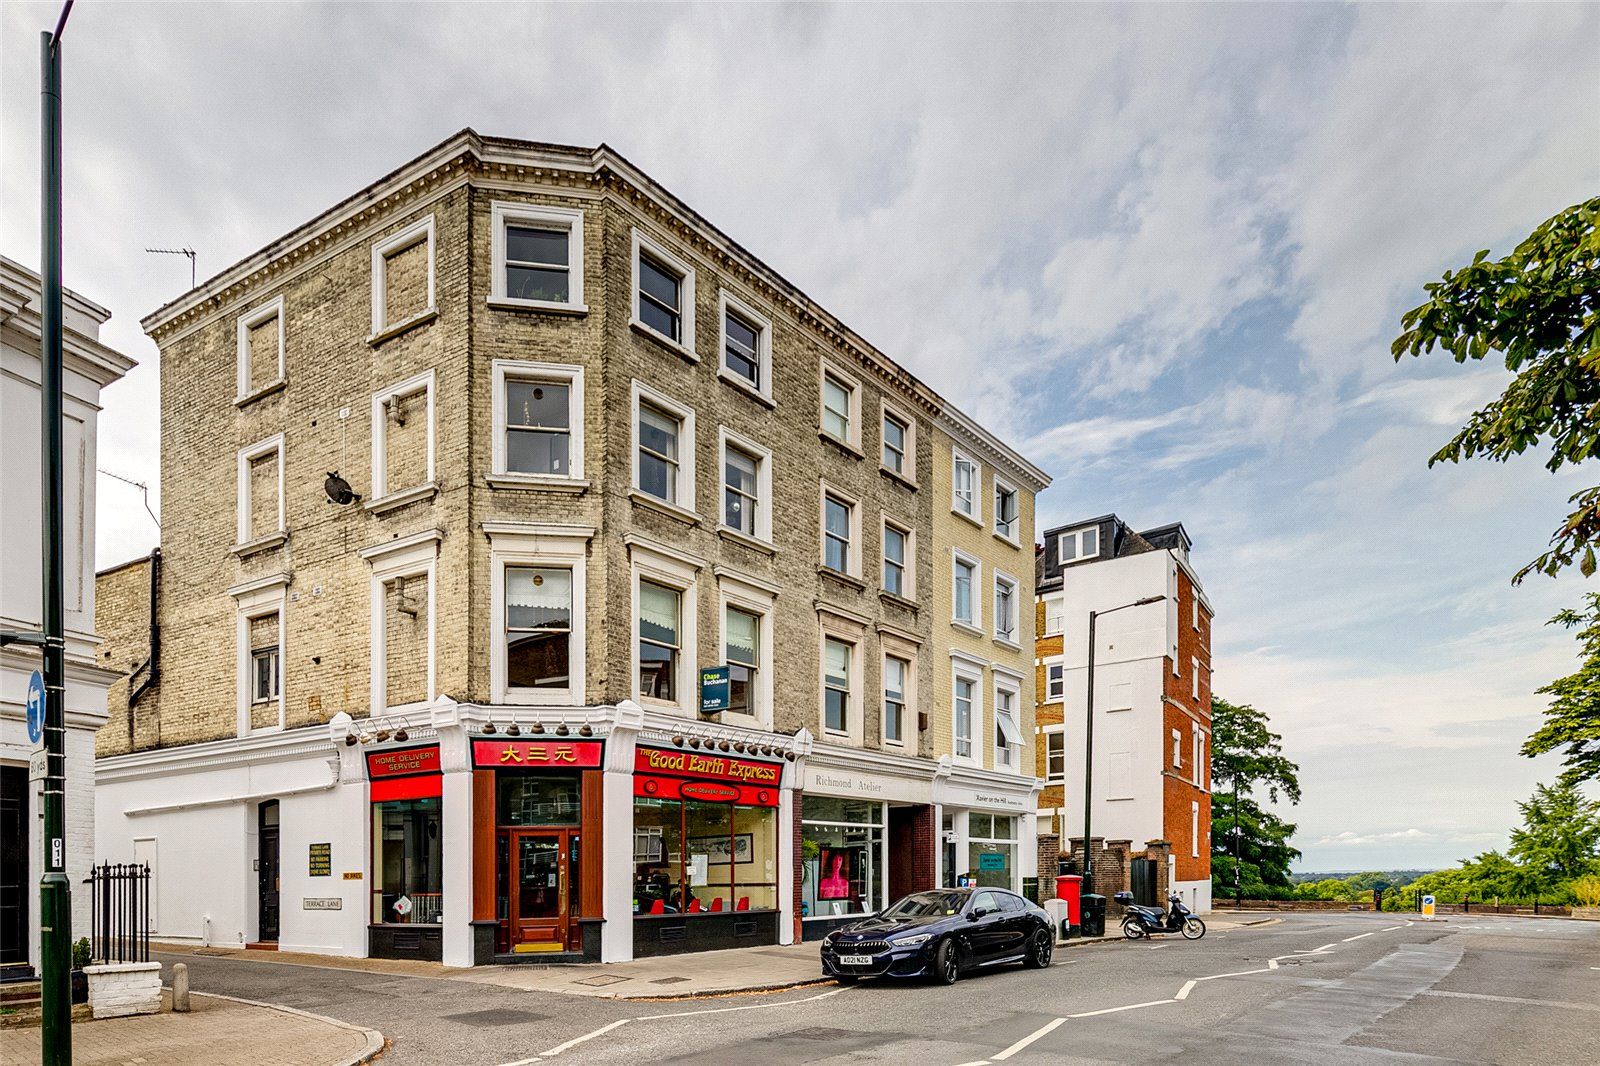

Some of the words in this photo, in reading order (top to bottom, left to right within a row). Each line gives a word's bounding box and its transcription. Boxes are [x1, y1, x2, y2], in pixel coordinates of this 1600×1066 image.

[375, 756, 397, 765] HOME
[399, 752, 435, 762] DELIVERY
[500, 744, 577, 763] 大三元
[389, 761, 421, 771] SERVICE
[640, 748, 651, 757] THE
[649, 750, 685, 770] Good
[688, 755, 724, 775] Earth
[728, 760, 776, 781] Express
[815, 774, 852, 789] Richmond
[858, 779, 882, 792] Atelier
[976, 794, 988, 802] Xavier
[53, 840, 61, 866] 011
[305, 900, 325, 908] TERRACE
[327, 900, 340, 908] LANE
